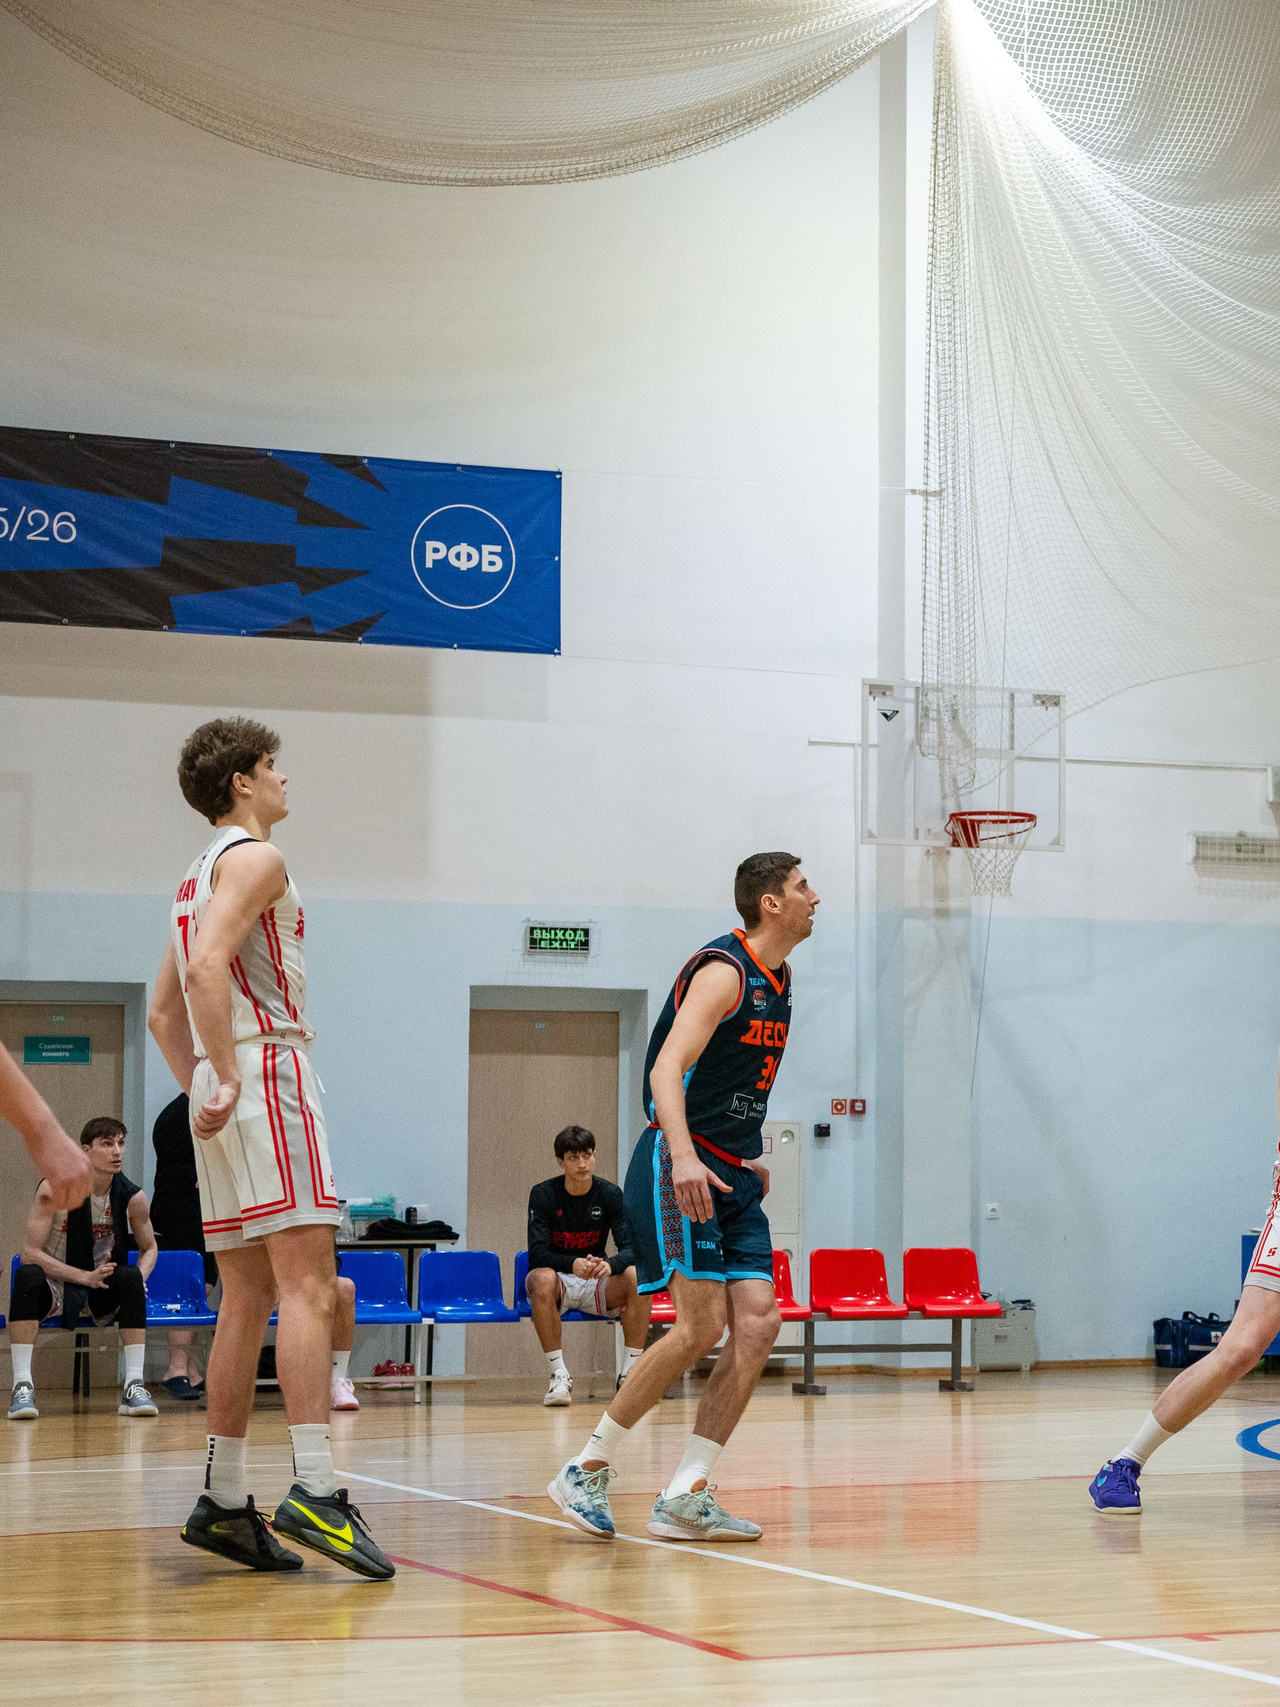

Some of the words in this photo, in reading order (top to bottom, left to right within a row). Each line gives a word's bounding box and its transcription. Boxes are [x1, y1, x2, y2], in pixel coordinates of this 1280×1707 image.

[425, 540, 503, 573] РФБ
[533, 929, 585, 942] ВЫХОД
[540, 940, 578, 949] EXIT
[695, 1241, 716, 1250] TEAM
